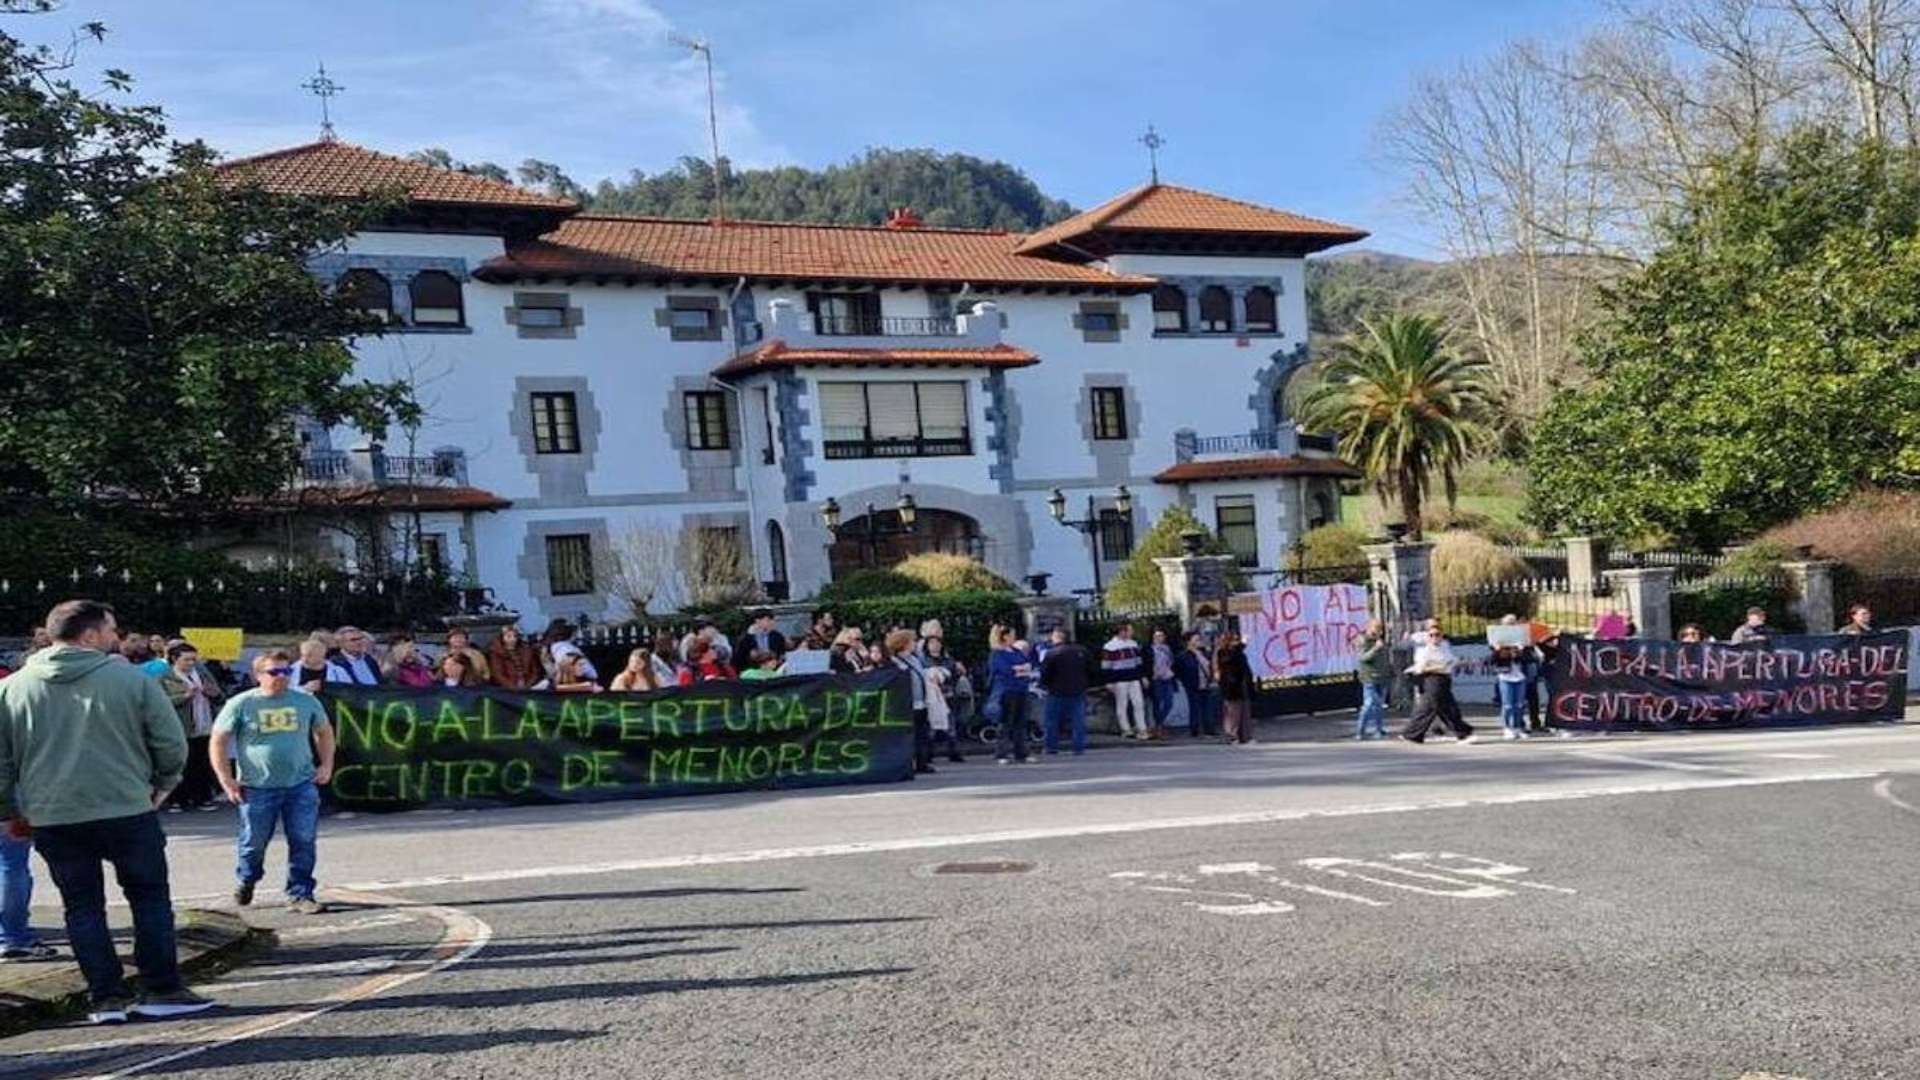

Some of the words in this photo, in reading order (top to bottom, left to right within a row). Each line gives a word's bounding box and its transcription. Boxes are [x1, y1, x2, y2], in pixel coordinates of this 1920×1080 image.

[1254, 589, 1301, 632] NO
[1323, 586, 1366, 622] AL
[1263, 622, 1367, 673] CENTR
[332, 758, 532, 800] CENTRO
[562, 750, 624, 791] DE
[650, 738, 871, 784] MENORES
